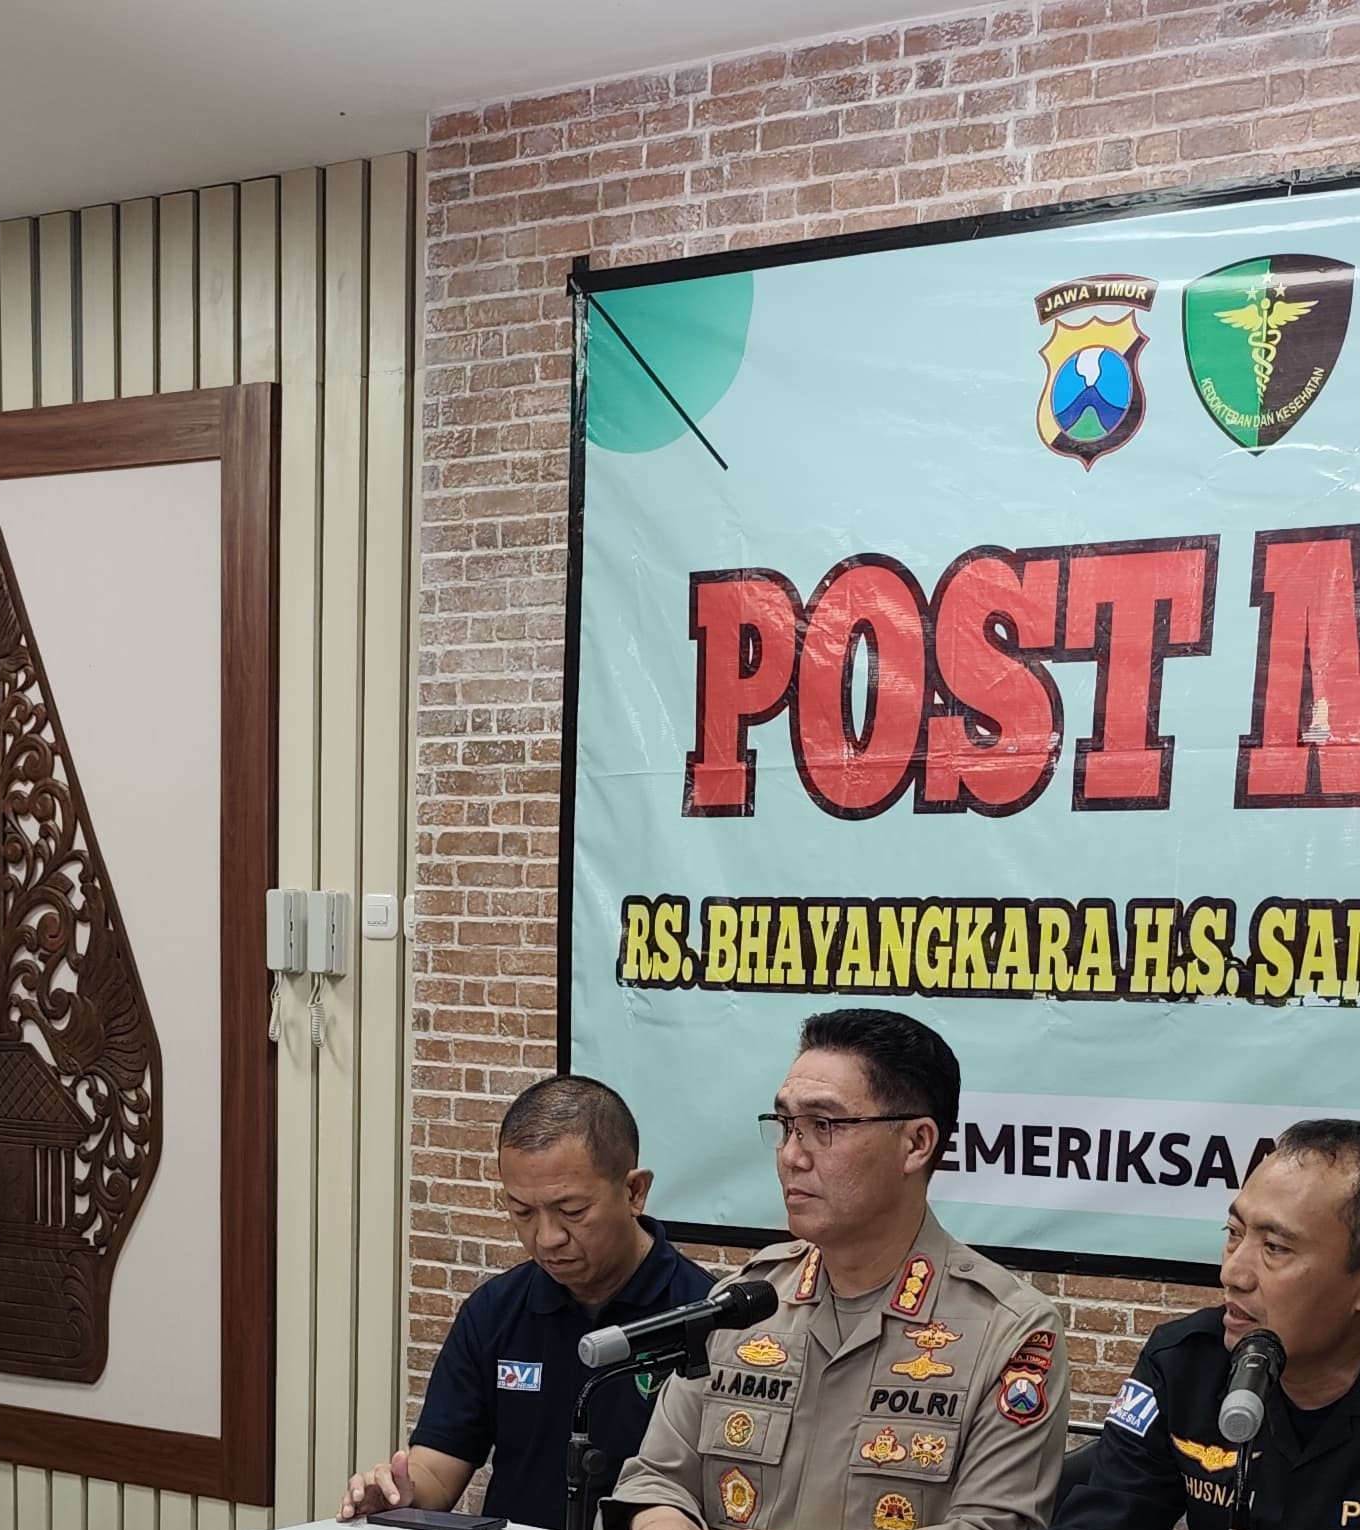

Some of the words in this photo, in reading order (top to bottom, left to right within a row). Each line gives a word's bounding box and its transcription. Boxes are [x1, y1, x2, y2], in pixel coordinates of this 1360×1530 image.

[1043, 286, 1090, 313] JAWA
[1094, 282, 1148, 301] TIMUR
[1253, 411, 1275, 428] DAN
[1275, 366, 1326, 423] KESEHATAN
[684, 536, 1219, 819] POST
[621, 901, 694, 983] RS.
[704, 902, 1117, 994] BHAYANGKARA
[1127, 905, 1241, 998] H.S.
[934, 1121, 1278, 1190] EMERIKSAA
[498, 1365, 540, 1385] DVI
[870, 1389, 958, 1418] POLRI
